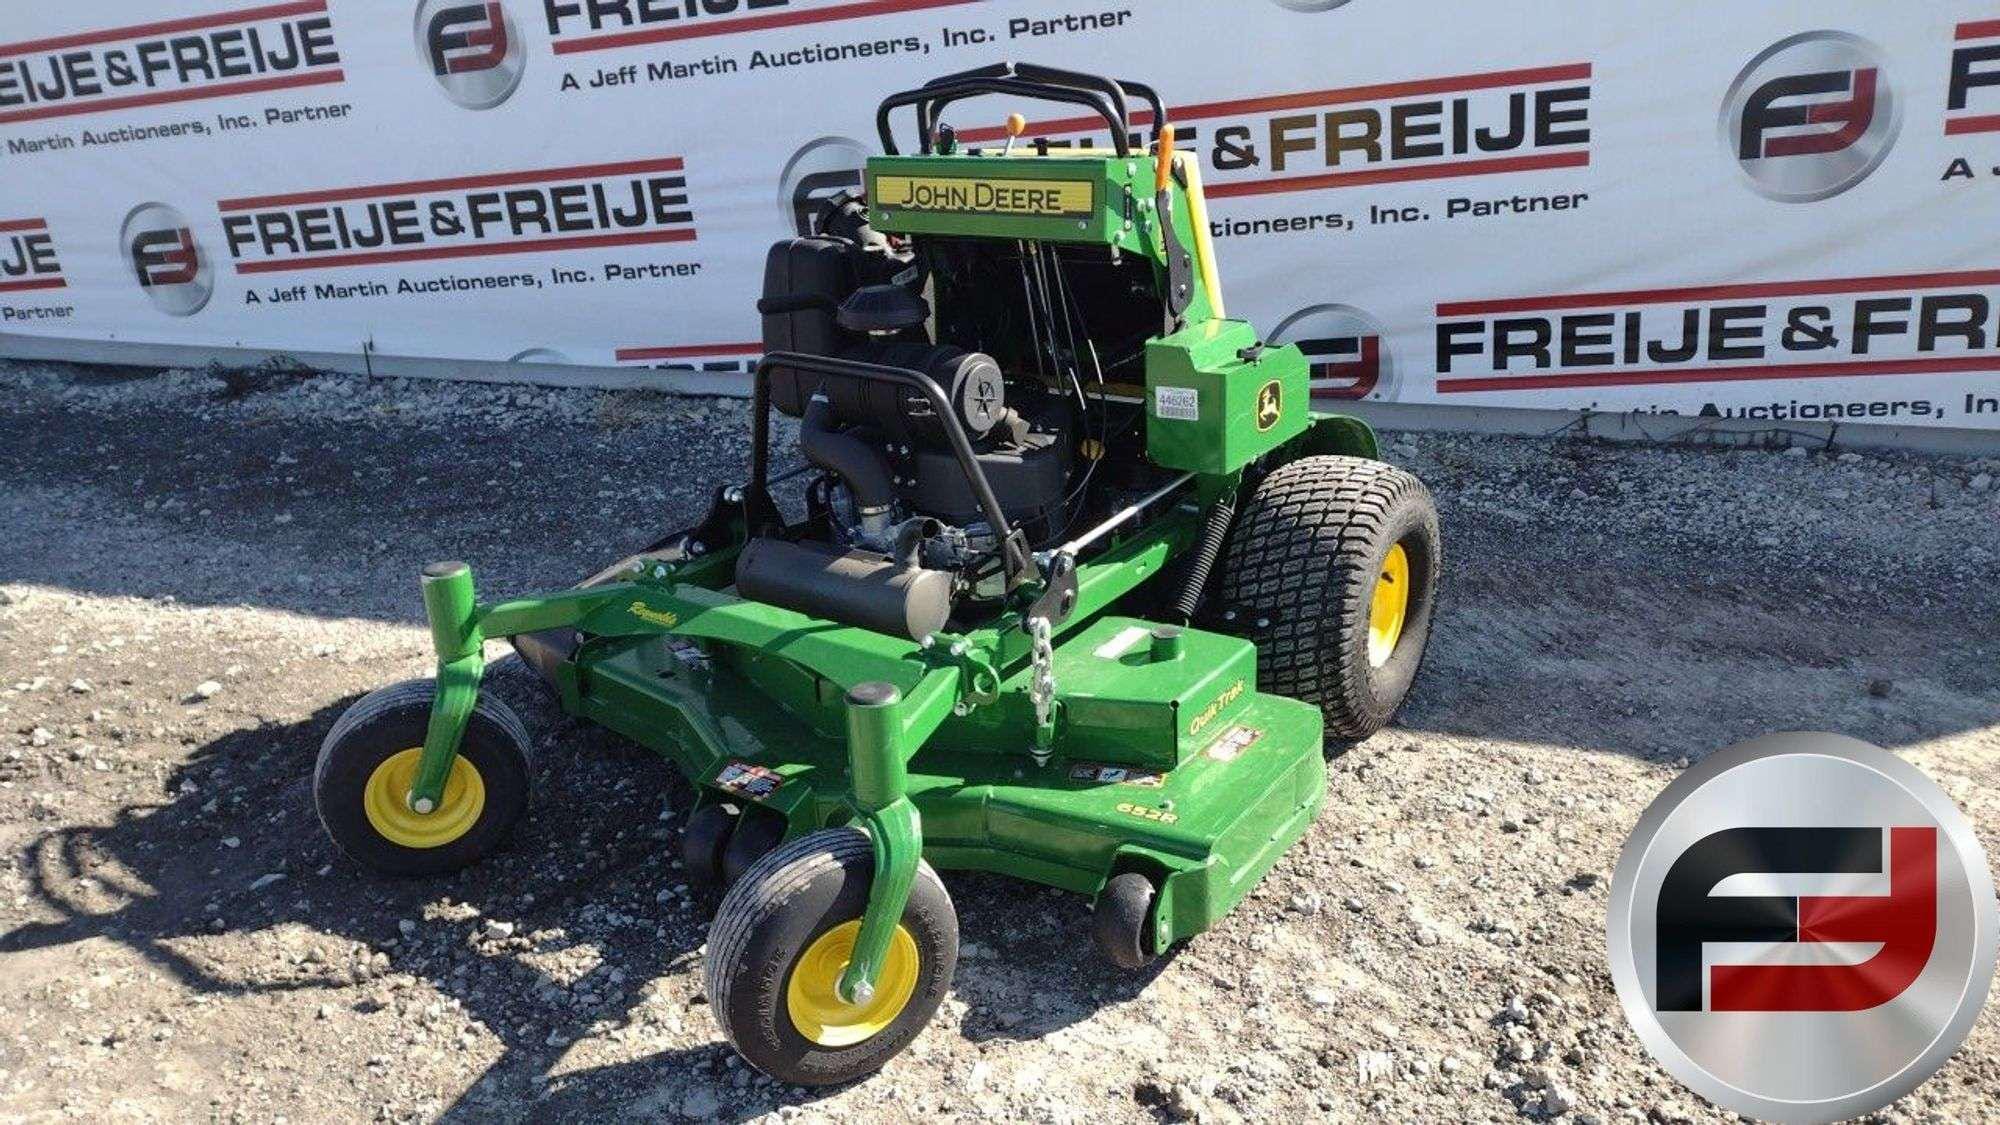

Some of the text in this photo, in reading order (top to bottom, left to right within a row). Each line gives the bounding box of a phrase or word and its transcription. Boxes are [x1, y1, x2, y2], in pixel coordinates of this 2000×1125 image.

[560, 10, 1132, 91] A Jeff Martin Auctioneers, Inc. Partner
[8, 102, 352, 155] Martin Auctioneers, Inc. Partner
[1940, 158, 1974, 180] A
[902, 180, 1061, 210] JOHN DEERE
[1210, 193, 1588, 238] tioneers, Inc. Partner
[0, 233, 61, 277] JE
[246, 261, 702, 304] A Jeff Martin Auctioneers, Inc. Partner
[2, 306, 74, 321] Partner
